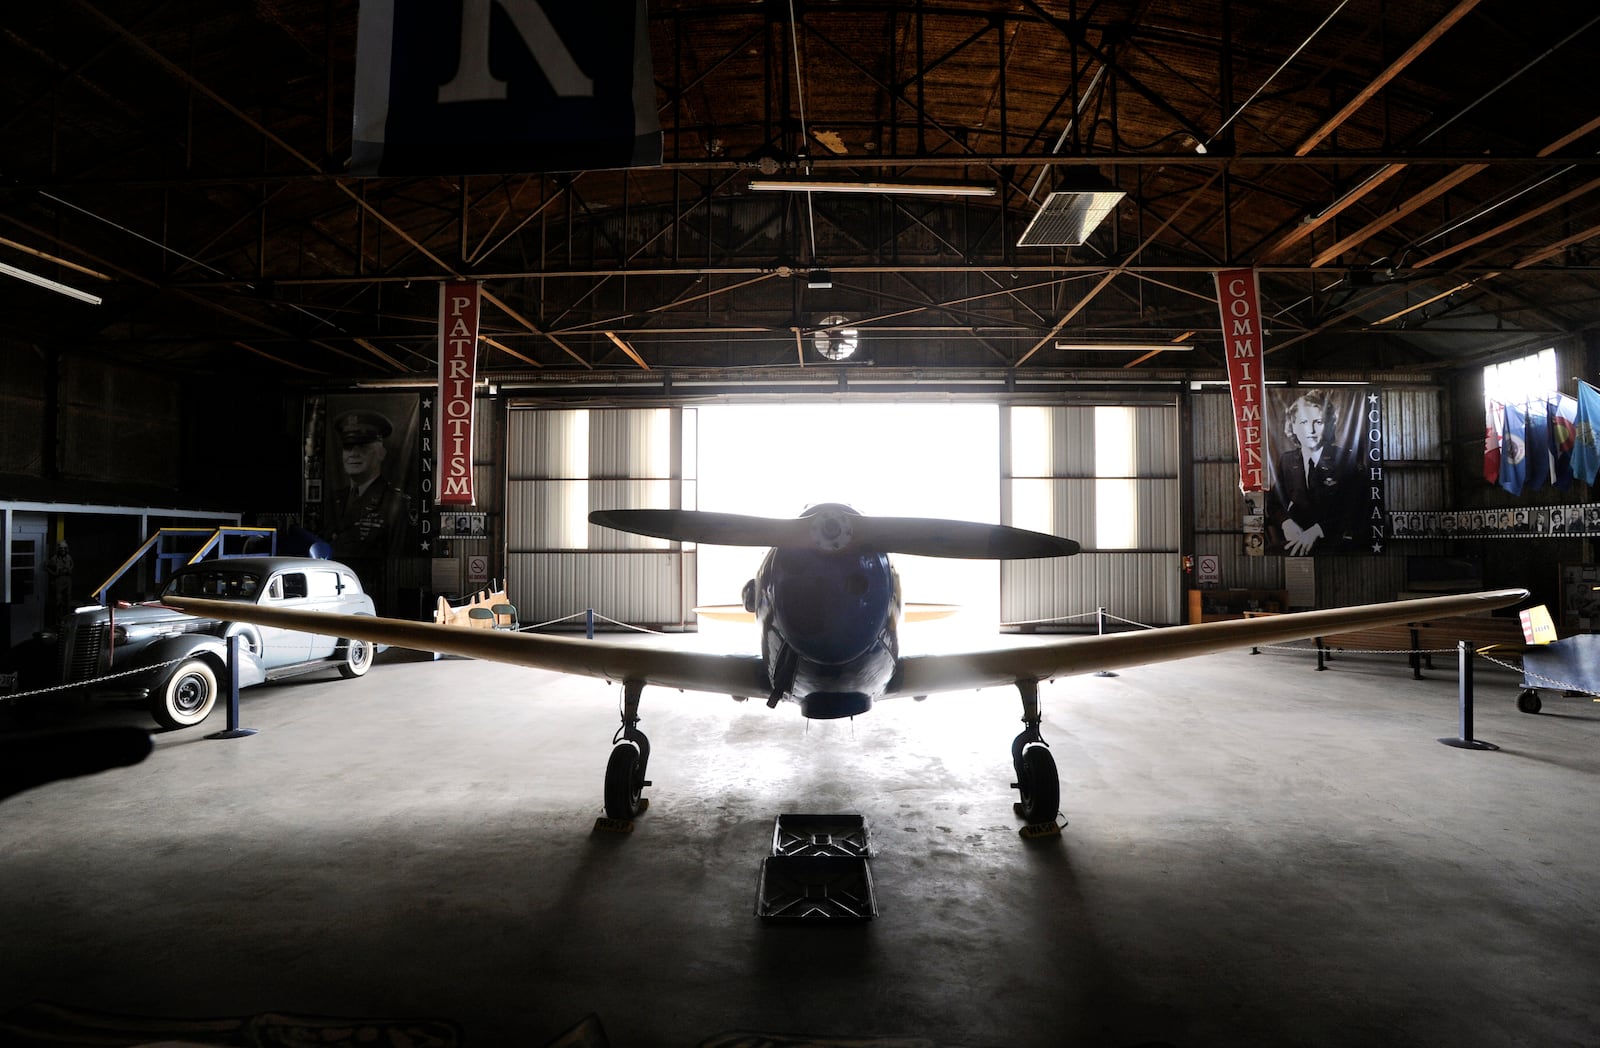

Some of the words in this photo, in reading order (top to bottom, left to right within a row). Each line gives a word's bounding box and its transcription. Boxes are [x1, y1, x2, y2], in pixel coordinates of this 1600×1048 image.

[444, 296, 471, 495] PATRIOTISM
[1229, 279, 1263, 487] COMMITMENT
[421, 417, 431, 534] ARNOLD
[1368, 409, 1384, 539] COCHRAN
